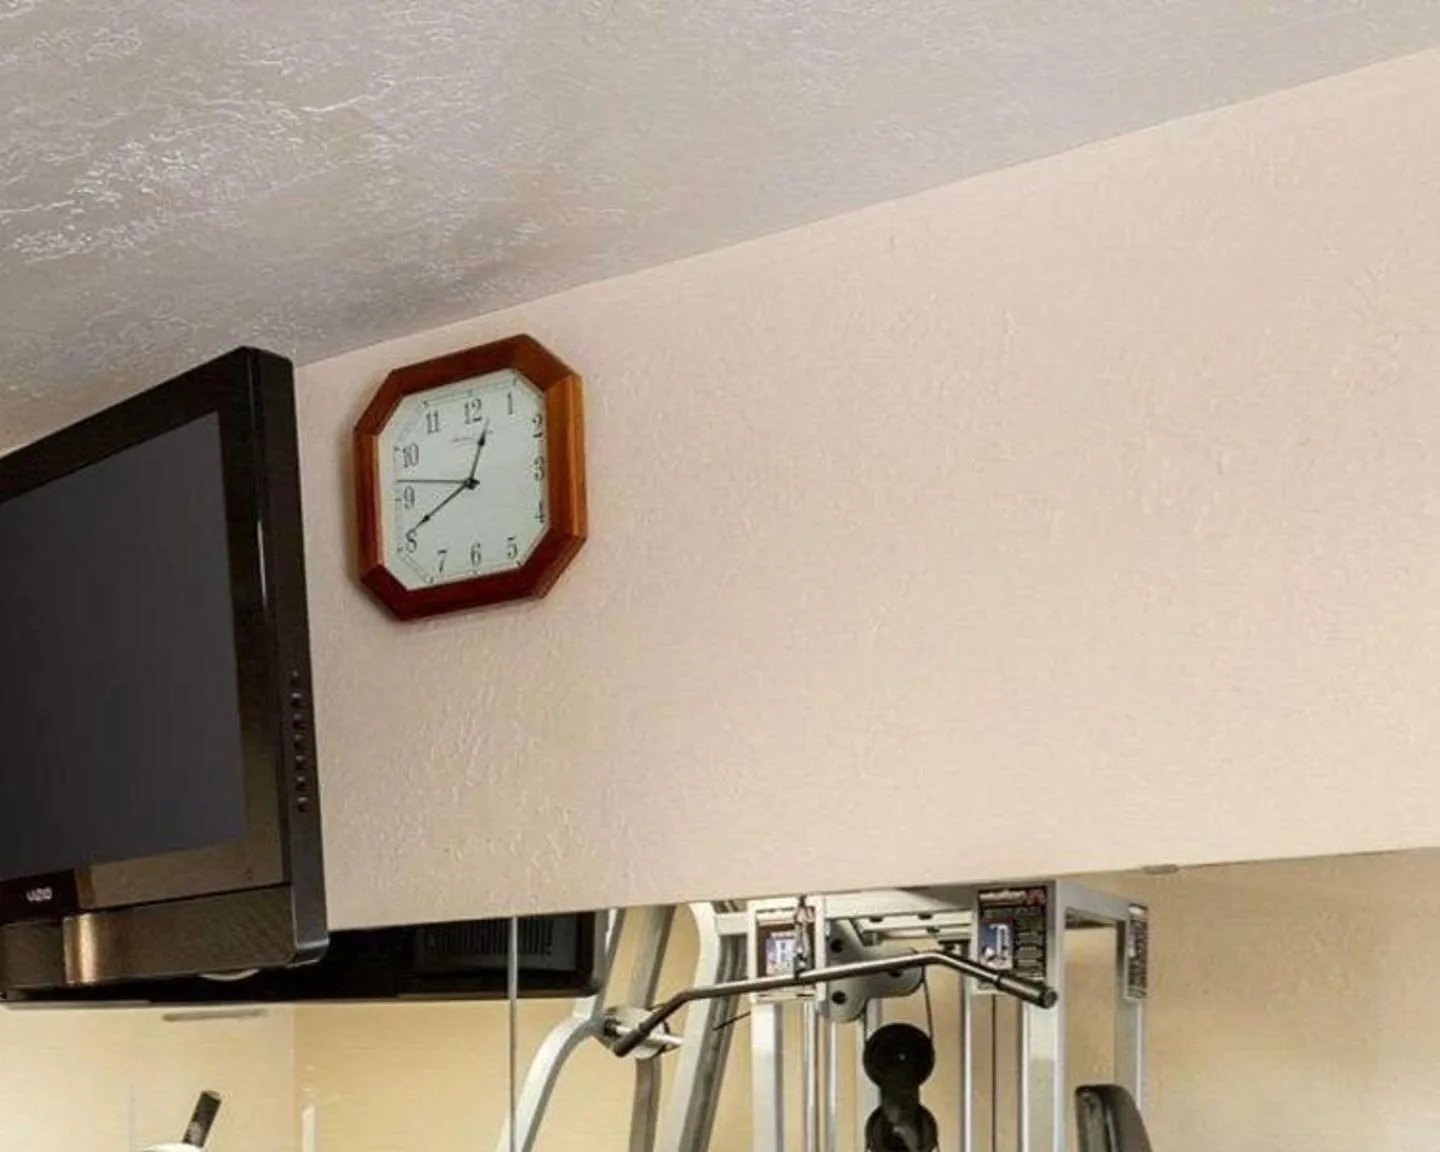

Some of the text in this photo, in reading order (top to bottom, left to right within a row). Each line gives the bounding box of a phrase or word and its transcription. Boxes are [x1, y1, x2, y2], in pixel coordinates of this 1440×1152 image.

[464, 398, 483, 425] 12
[506, 392, 516, 416] 1
[426, 411, 440, 435] 11
[532, 414, 544, 439] 2
[402, 443, 419, 468] 10
[534, 457, 545, 482] 3
[403, 488, 416, 510] 9
[405, 529, 418, 553] 8
[507, 537, 519, 559] 5
[437, 550, 447, 572] 7
[470, 543, 481, 565] 6
